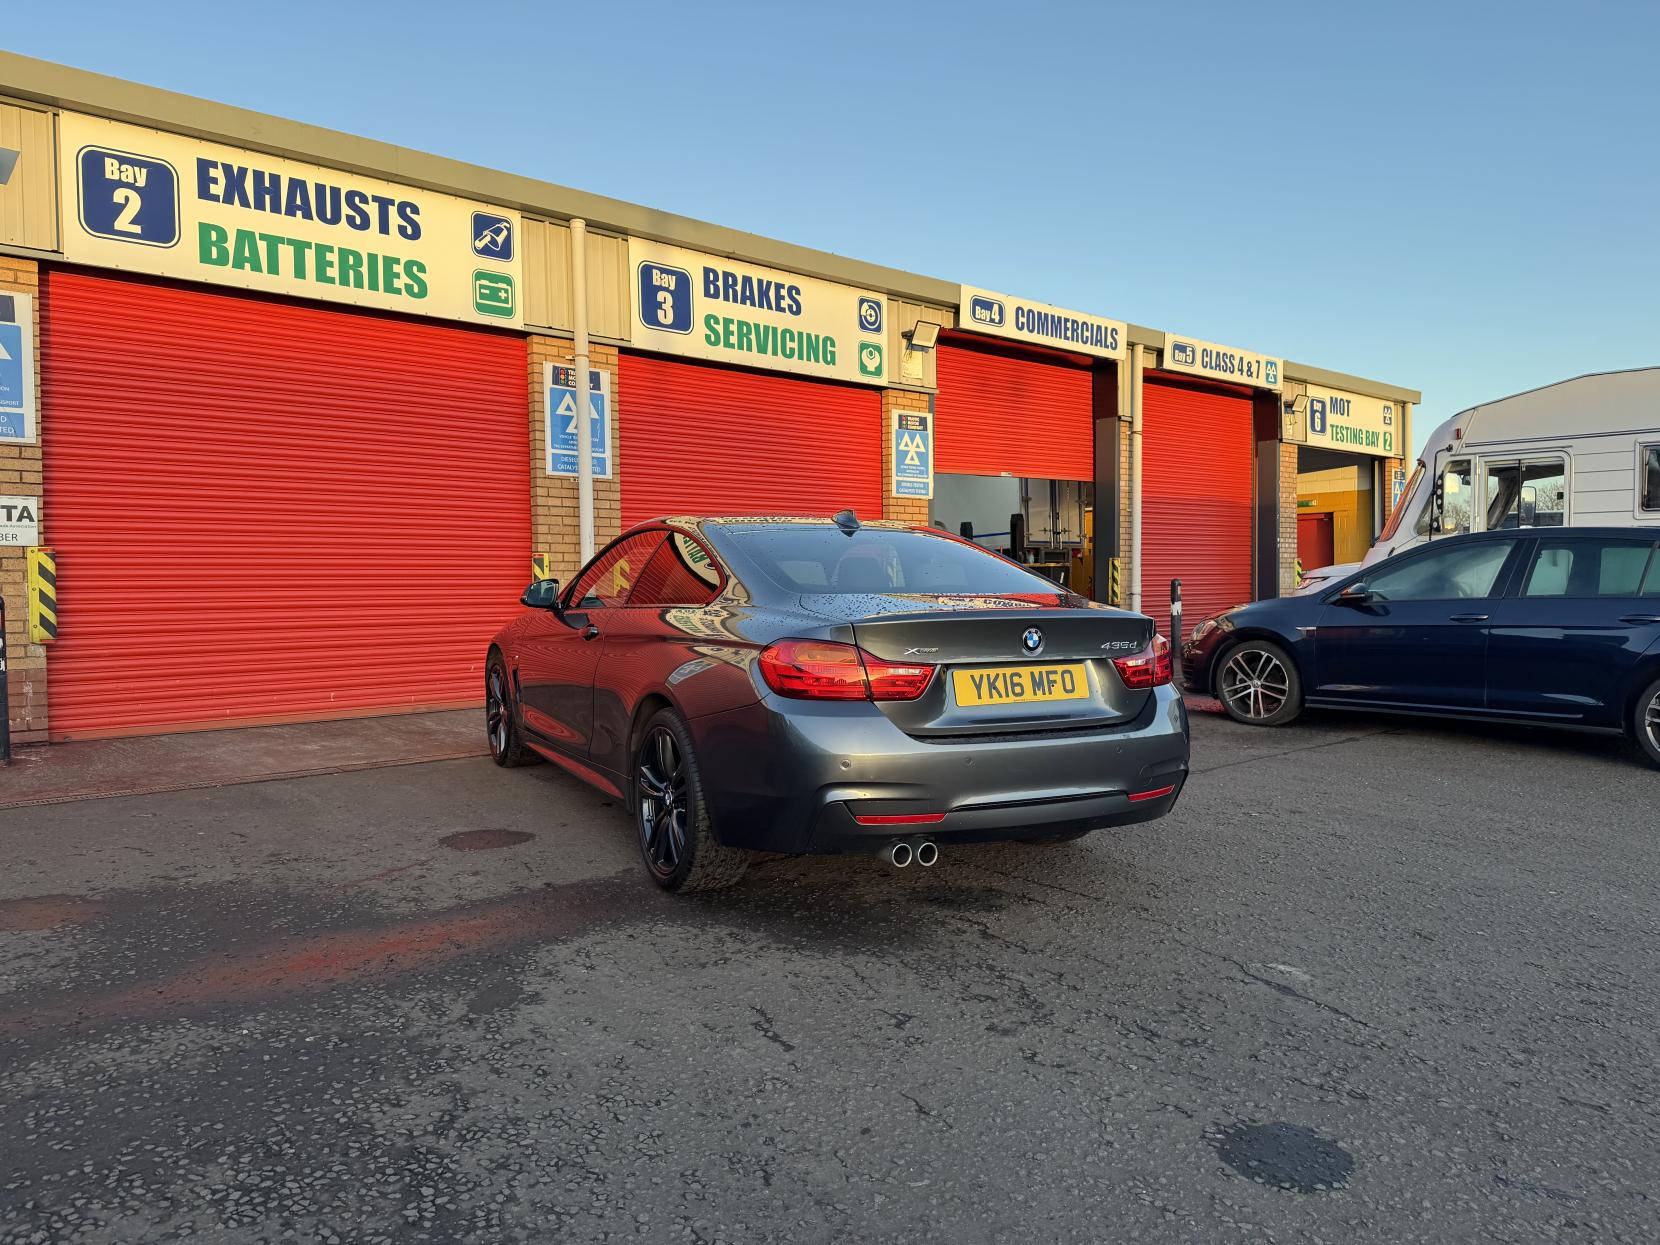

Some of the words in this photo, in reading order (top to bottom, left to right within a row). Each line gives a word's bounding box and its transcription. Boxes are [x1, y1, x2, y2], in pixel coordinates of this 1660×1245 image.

[104, 157, 147, 188] Bay
[112, 187, 142, 234] 2
[196, 157, 422, 241] EXHAUSTS
[198, 221, 428, 299] BATTERIES
[652, 268, 676, 291] Bay
[703, 265, 802, 316] BRAKES
[656, 290, 674, 325] 3
[975, 305, 990, 322] Bay
[991, 303, 1000, 323] 4
[704, 313, 836, 366] SERVICING
[1015, 306, 1119, 351] COMMERCIALS
[1186, 346, 1194, 363] 5
[1201, 348, 1235, 374] CLASS
[1237, 356, 1245, 376] 4
[1246, 361, 1254, 378] &
[1255, 360, 1262, 379] 7
[1314, 412, 1321, 431] 6
[1329, 396, 1352, 417] MOT
[1329, 423, 1363, 446] TESTING
[1365, 429, 1380, 448] BAY
[1385, 432, 1391, 450] 2
[1101, 641, 1137, 650] 435d
[970, 671, 1025, 699] YK16
[1031, 668, 1076, 697] MFO
